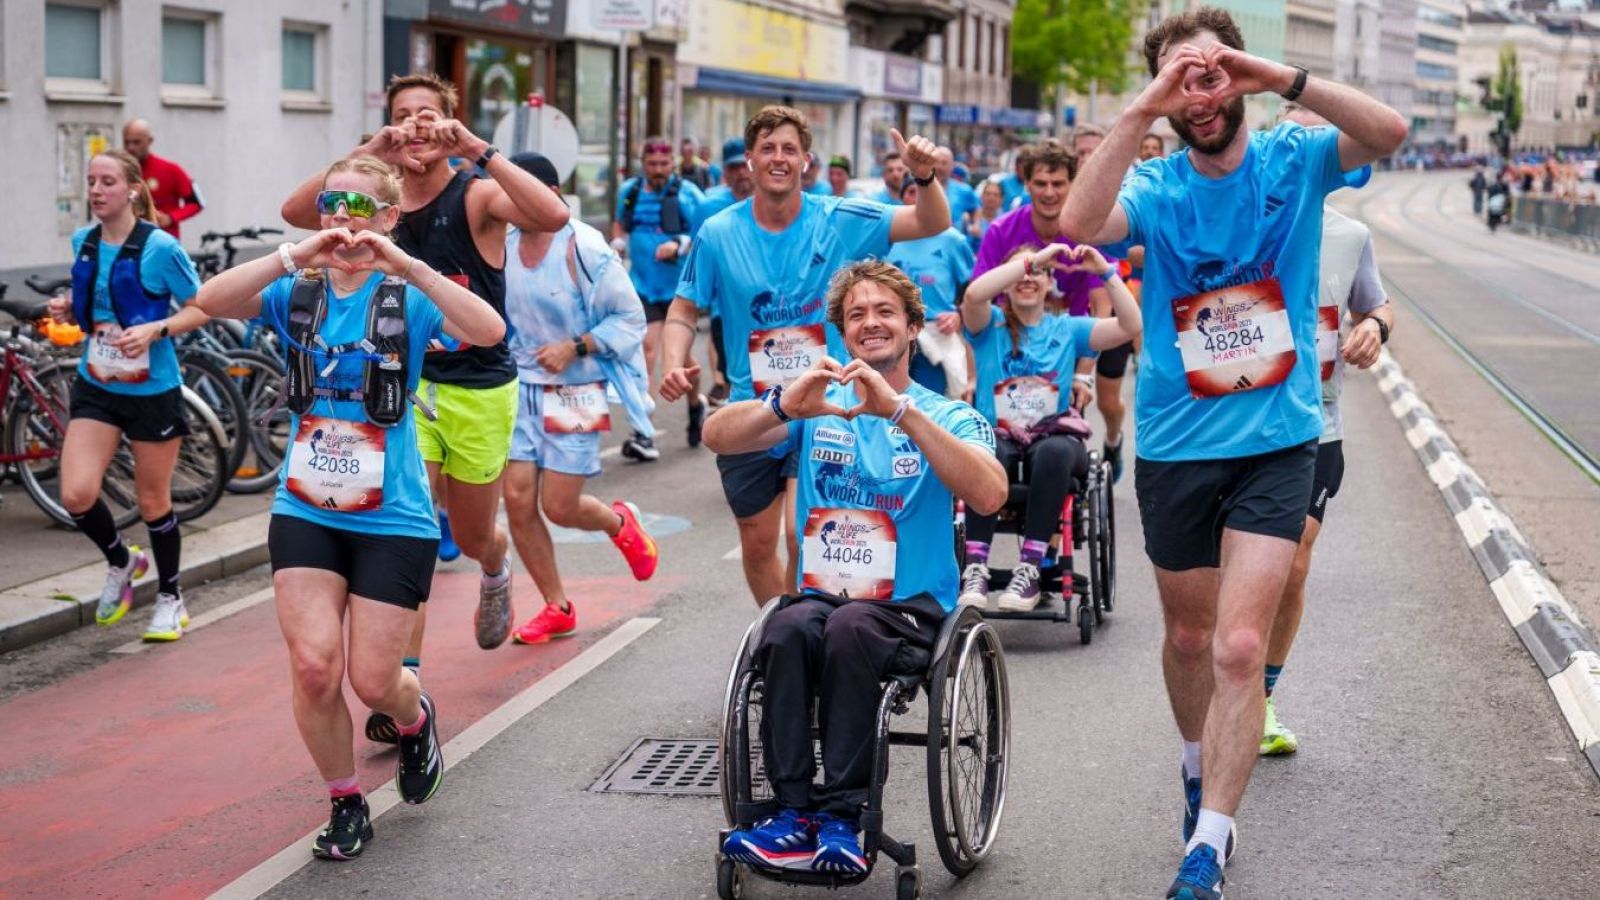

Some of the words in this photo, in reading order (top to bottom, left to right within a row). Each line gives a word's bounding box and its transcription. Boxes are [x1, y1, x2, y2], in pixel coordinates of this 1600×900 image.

[1214, 303, 1246, 317] WINGS
[1204, 326, 1264, 352] 48284
[768, 355, 811, 370] 46273
[1213, 347, 1257, 363] MARTIN
[816, 429, 842, 441] Allianz
[308, 454, 360, 474] 42038
[813, 448, 853, 464] RADO
[360, 493, 367, 505] 2
[822, 547, 873, 564] 44046
